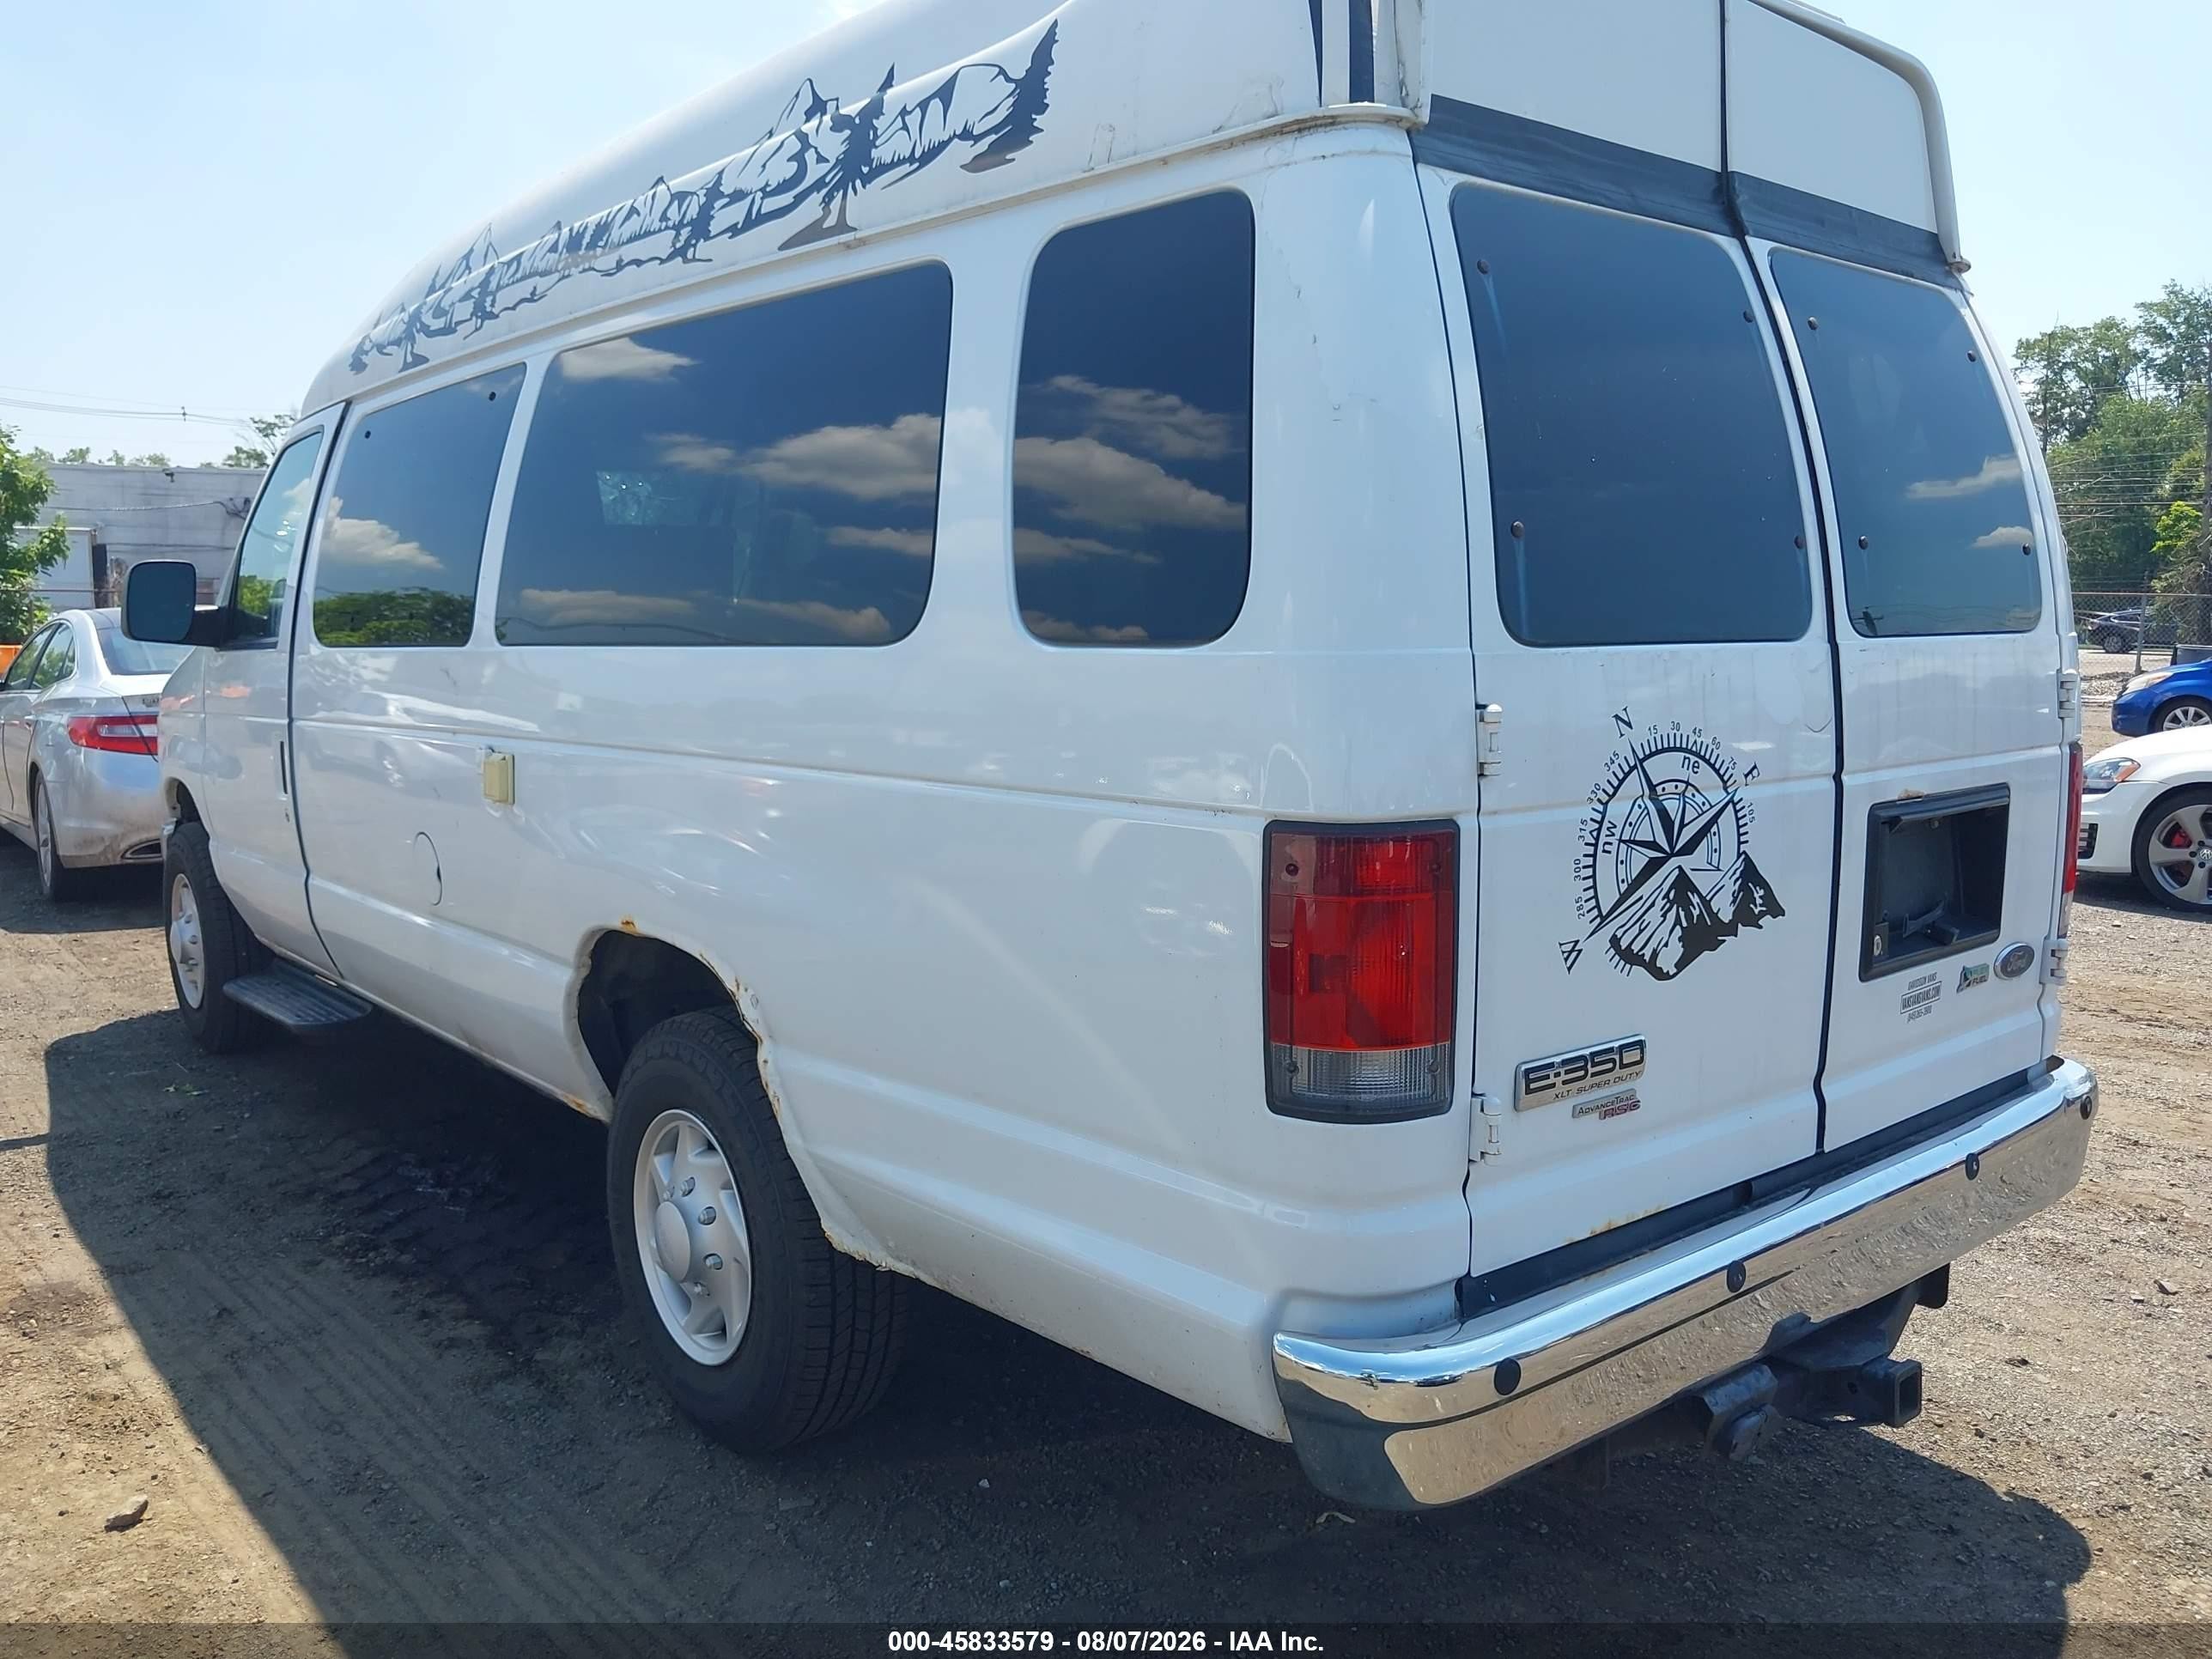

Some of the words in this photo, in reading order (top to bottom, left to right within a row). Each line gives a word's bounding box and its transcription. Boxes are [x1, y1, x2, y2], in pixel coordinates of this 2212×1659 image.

[1612, 707, 1633, 738] N
[1647, 725, 1658, 736] 15
[1670, 721, 1680, 732] 30
[1692, 726, 1703, 738] 45
[1711, 736, 1721, 750] 60
[1603, 750, 1620, 772] 345
[1681, 755, 1701, 775] ne
[1728, 757, 1738, 771] 75
[1742, 762, 1760, 787] E
[1587, 782, 1602, 805] 330
[1746, 802, 1756, 824] 105
[1577, 818, 1589, 842] 315
[1601, 820, 1618, 855] nw
[1573, 858, 1582, 882] 300
[1577, 896, 1586, 920] 285
[1558, 939, 1583, 975] W
[1524, 1039, 1644, 1096] E-350
[1553, 1089, 1572, 1101] XLT
[1576, 1079, 1610, 1095] SUPER
[1613, 1071, 1641, 1085] DUTY
